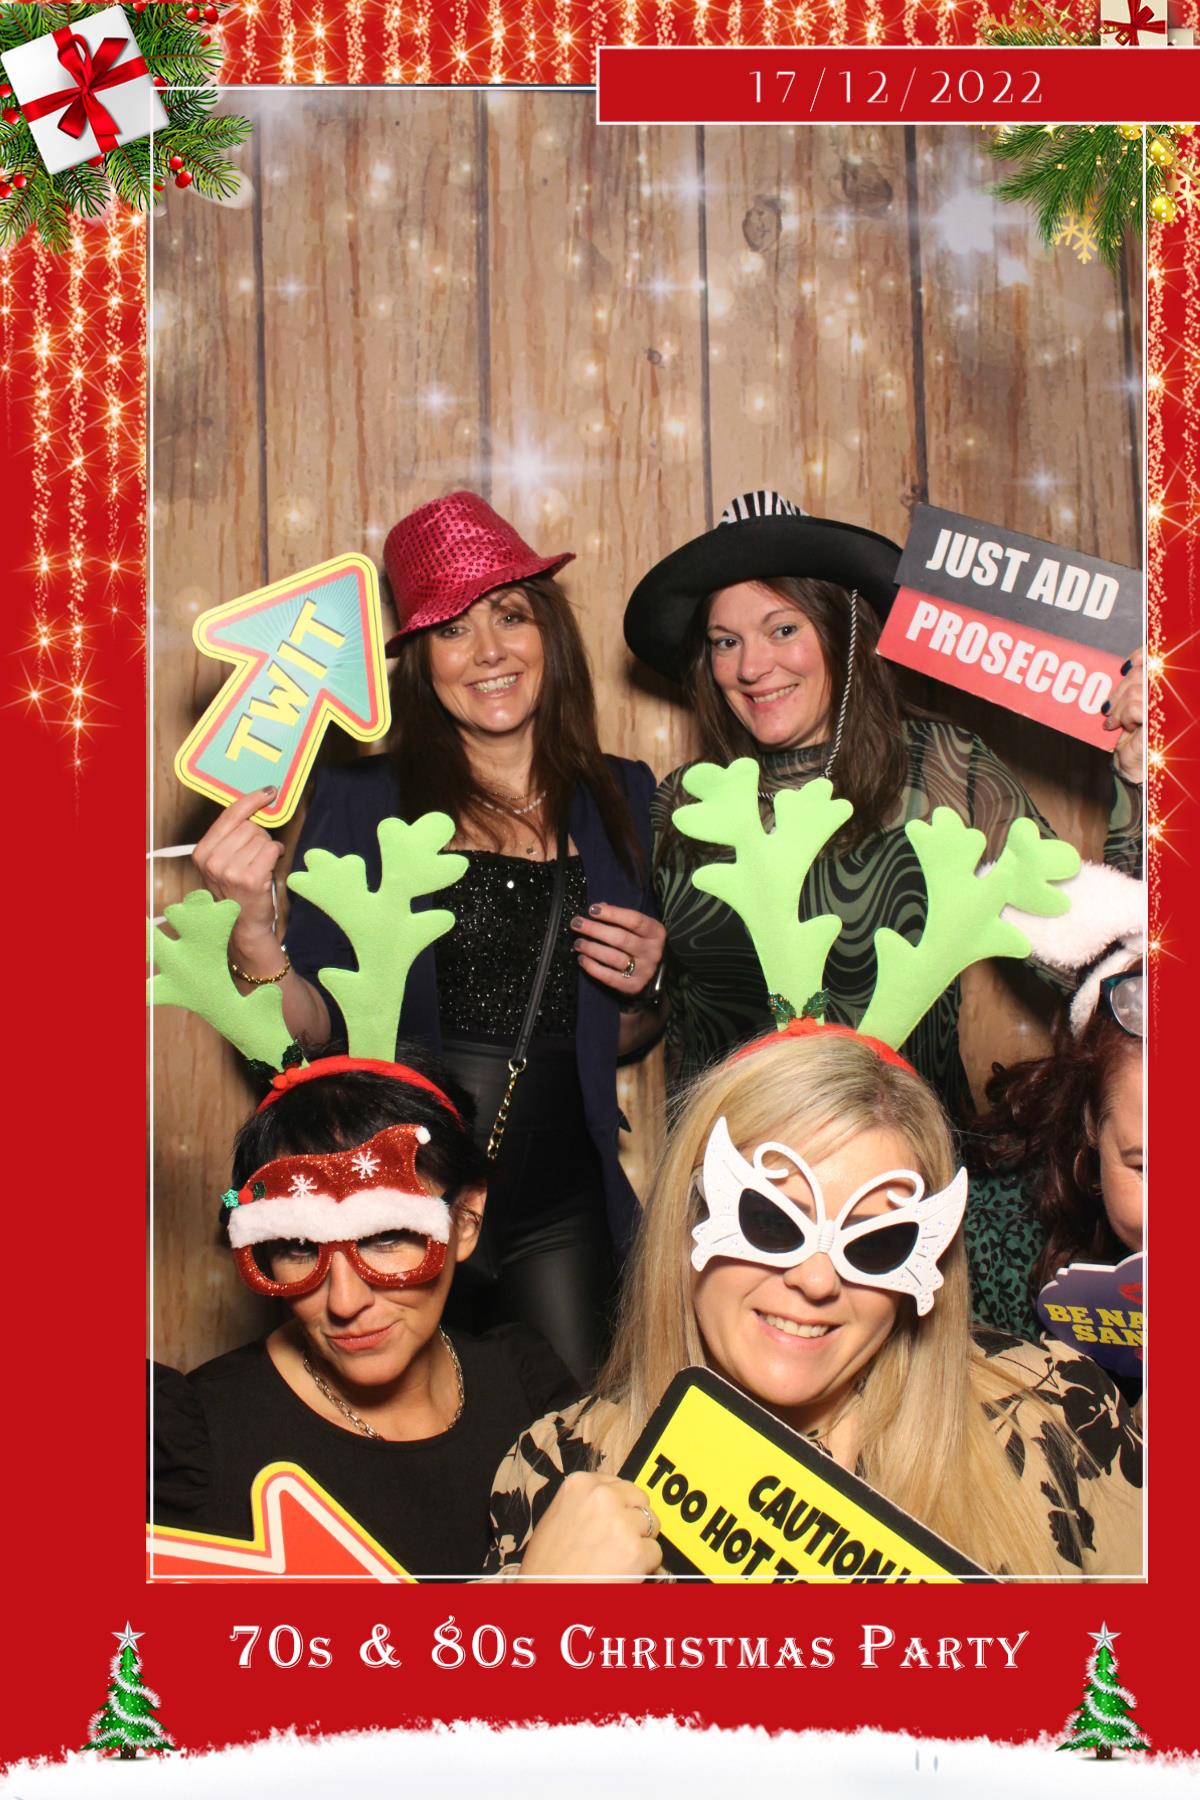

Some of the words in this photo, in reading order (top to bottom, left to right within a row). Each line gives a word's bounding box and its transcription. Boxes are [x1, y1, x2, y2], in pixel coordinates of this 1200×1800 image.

[924, 528, 1031, 594] JUST
[1026, 557, 1120, 621] ADD
[224, 597, 346, 764] TWIT
[905, 600, 1113, 715] PROSECCO
[1043, 1304, 1094, 1325] BE
[646, 1453, 708, 1523] TOO
[700, 1505, 776, 1580] HOT
